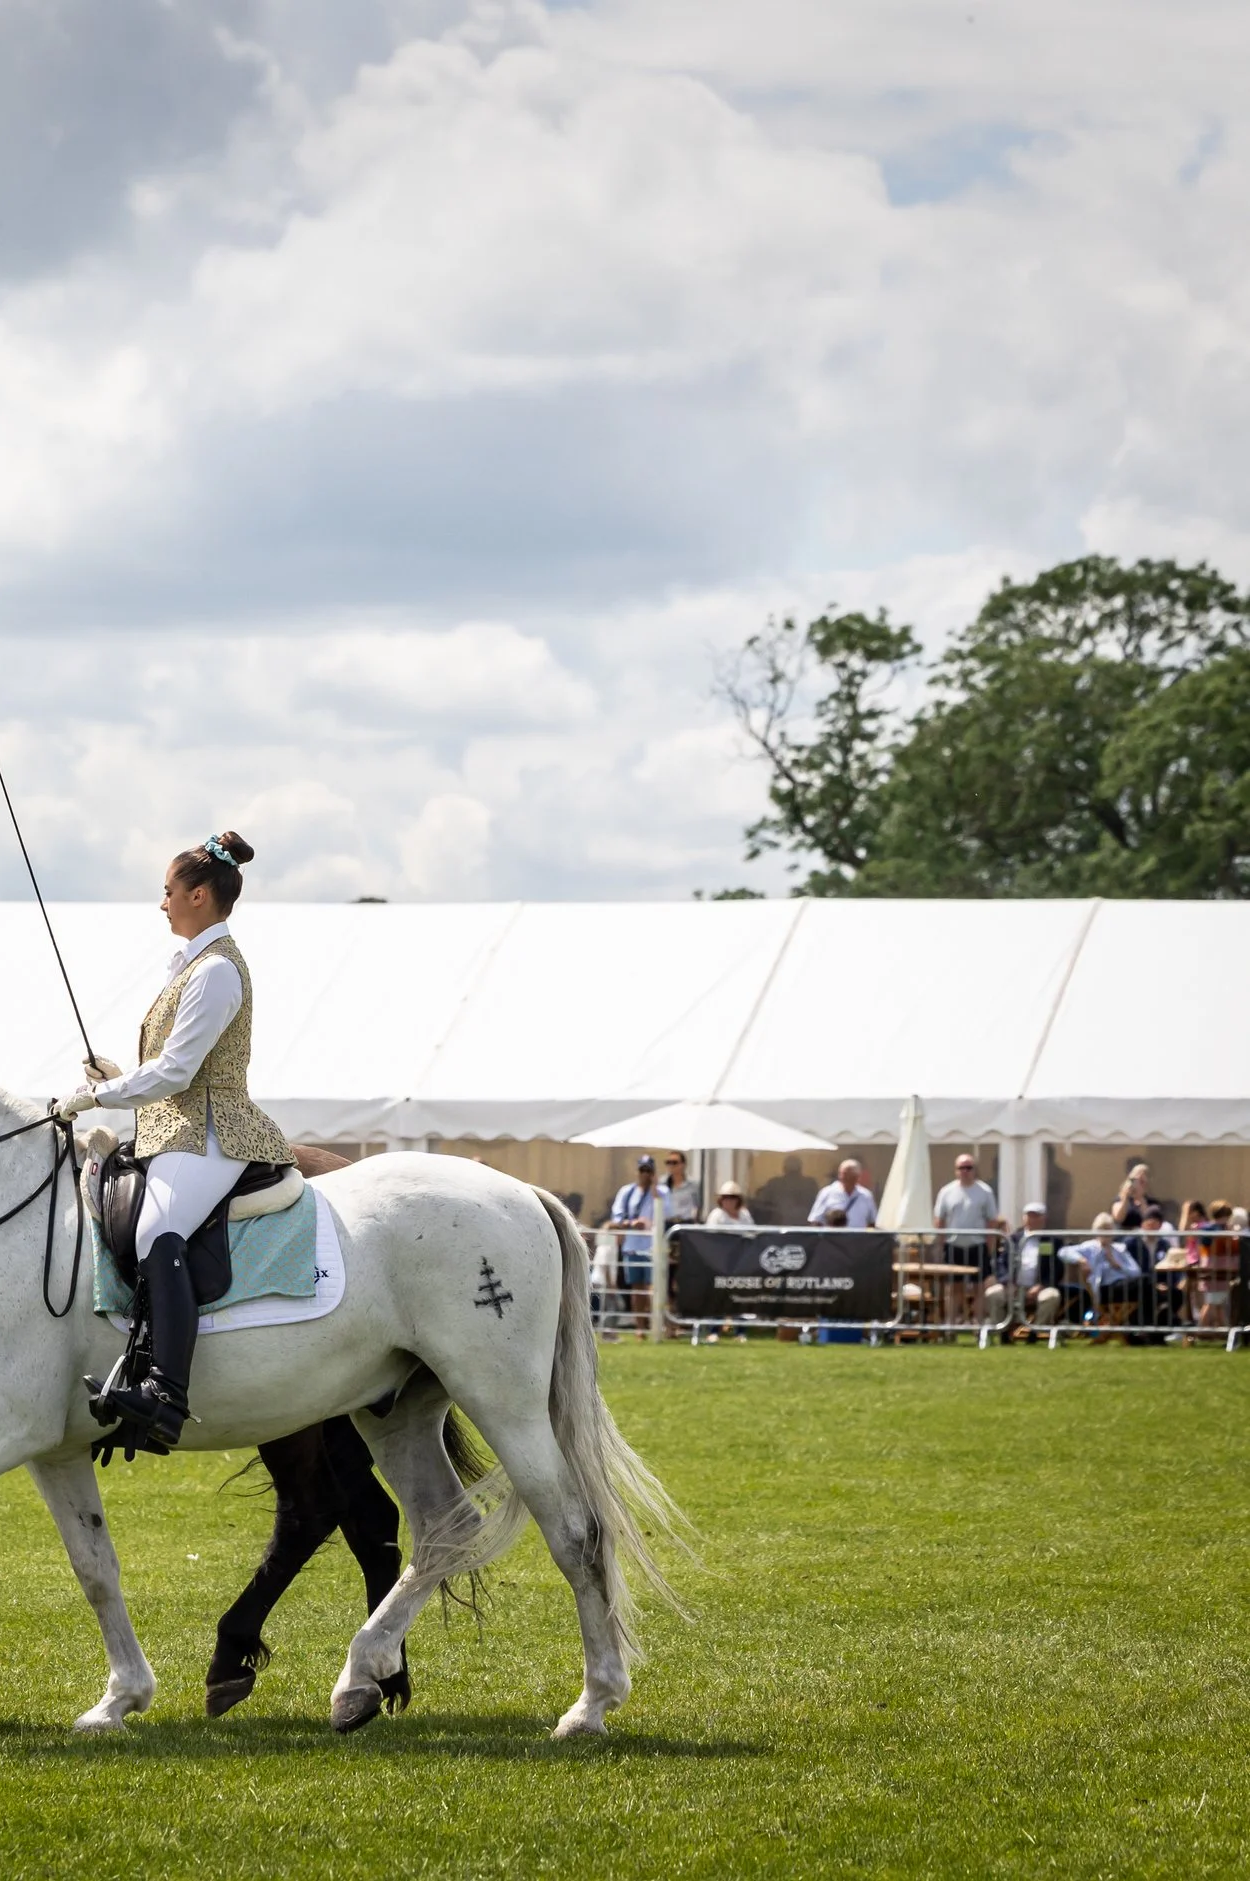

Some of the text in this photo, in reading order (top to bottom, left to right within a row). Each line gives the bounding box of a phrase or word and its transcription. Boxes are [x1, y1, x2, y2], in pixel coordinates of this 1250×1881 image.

[714, 1276, 854, 1290] HOUSE OF RUTLAND
